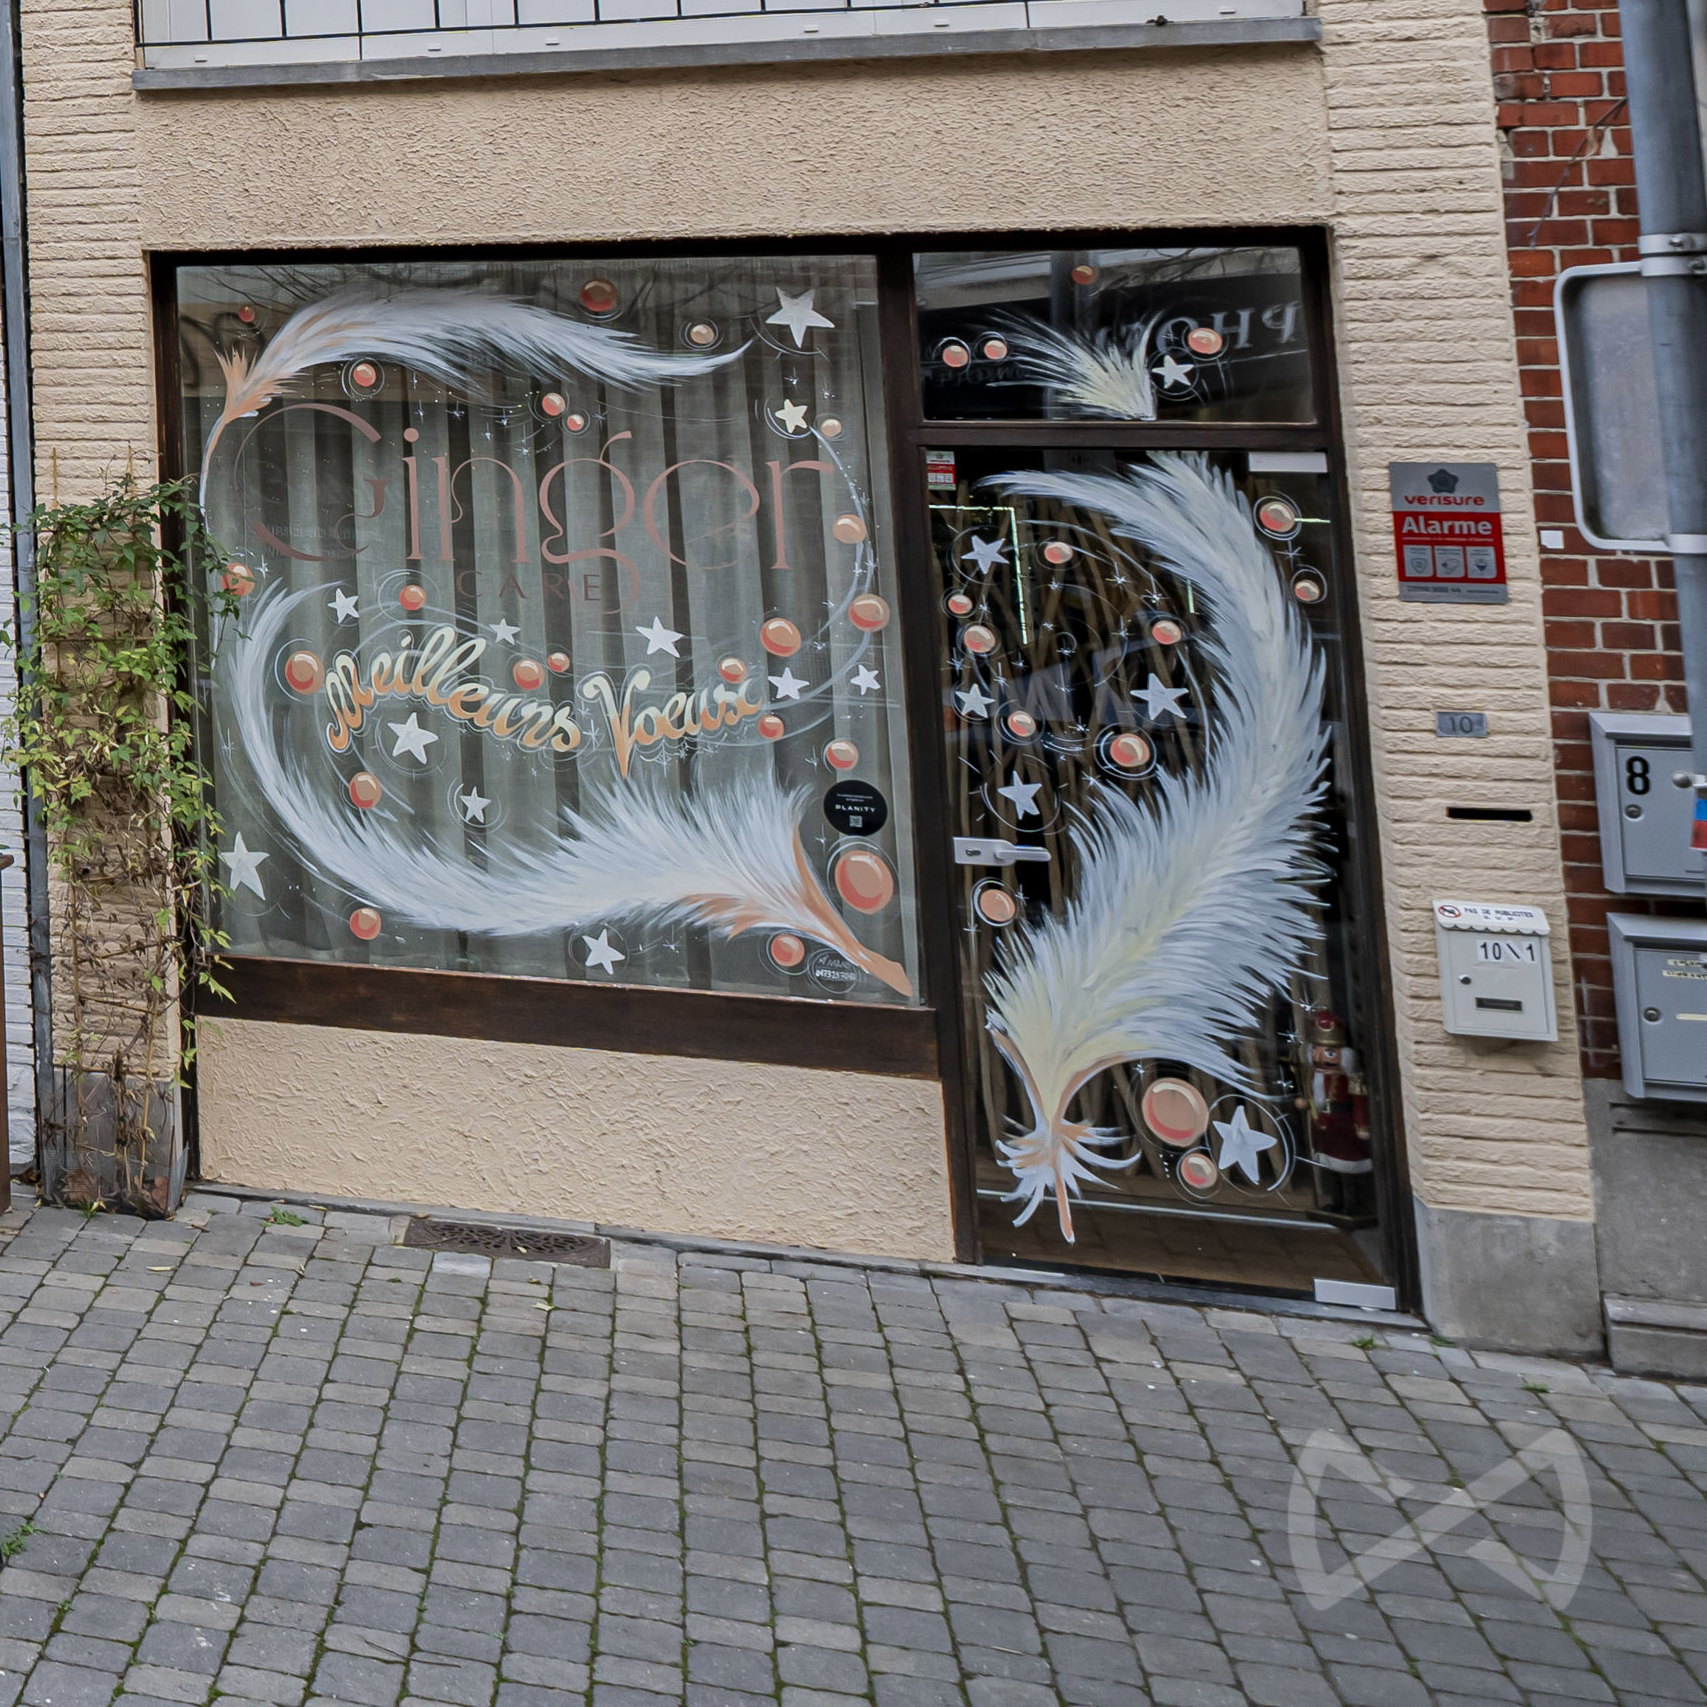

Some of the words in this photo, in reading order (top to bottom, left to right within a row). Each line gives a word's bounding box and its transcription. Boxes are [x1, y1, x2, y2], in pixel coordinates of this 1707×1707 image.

[233, 404, 835, 615] Ginger
[1404, 495, 1485, 506] verisure
[1402, 515, 1492, 535] Alarme
[455, 569, 601, 602] CARE
[325, 626, 581, 752] Meilleurs
[582, 669, 763, 779] Voeux
[1449, 716, 1474, 734] 10
[1625, 755, 1651, 795] 8
[835, 804, 875, 813] PLANITY
